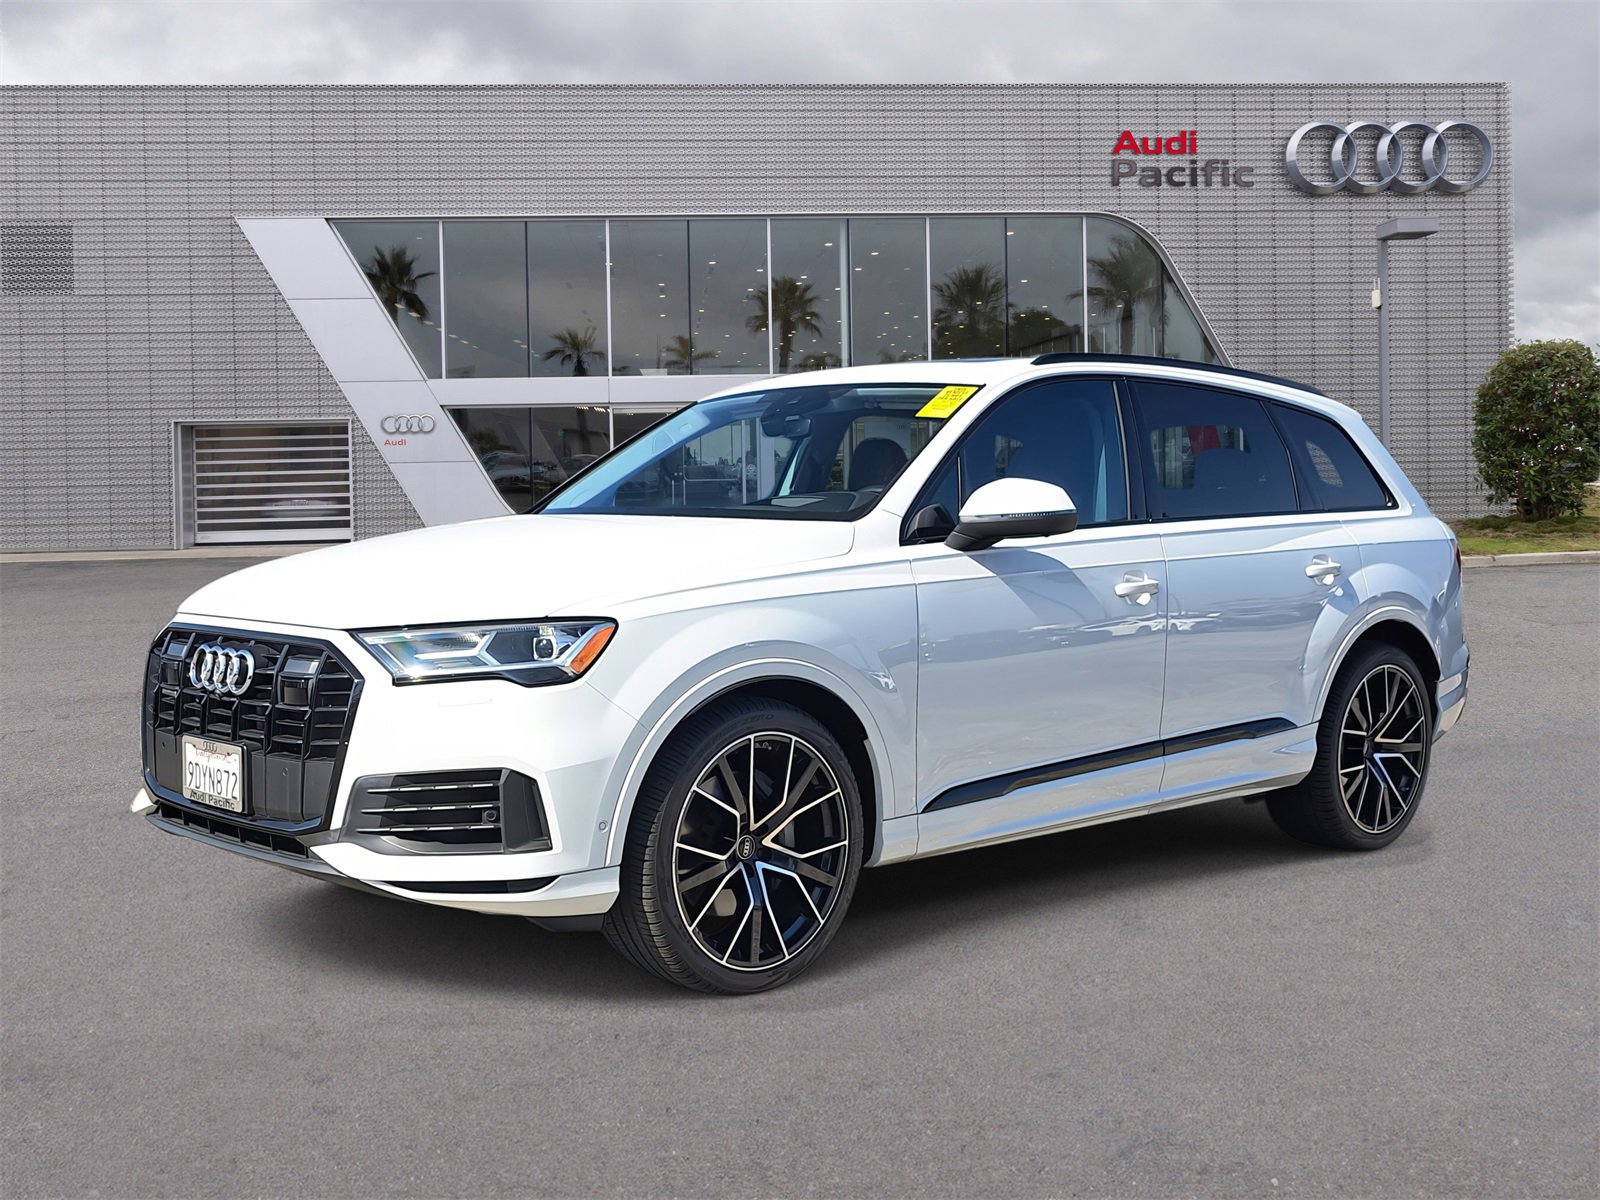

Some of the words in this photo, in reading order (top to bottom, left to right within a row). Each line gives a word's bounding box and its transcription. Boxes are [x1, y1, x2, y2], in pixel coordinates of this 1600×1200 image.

[1112, 130, 1197, 155] Audi
[1111, 159, 1254, 187] Pacific
[384, 438, 407, 446] Audi
[188, 760, 238, 800] 9DYN872
[190, 790, 207, 802] Audi
[208, 794, 236, 810] Pacific
